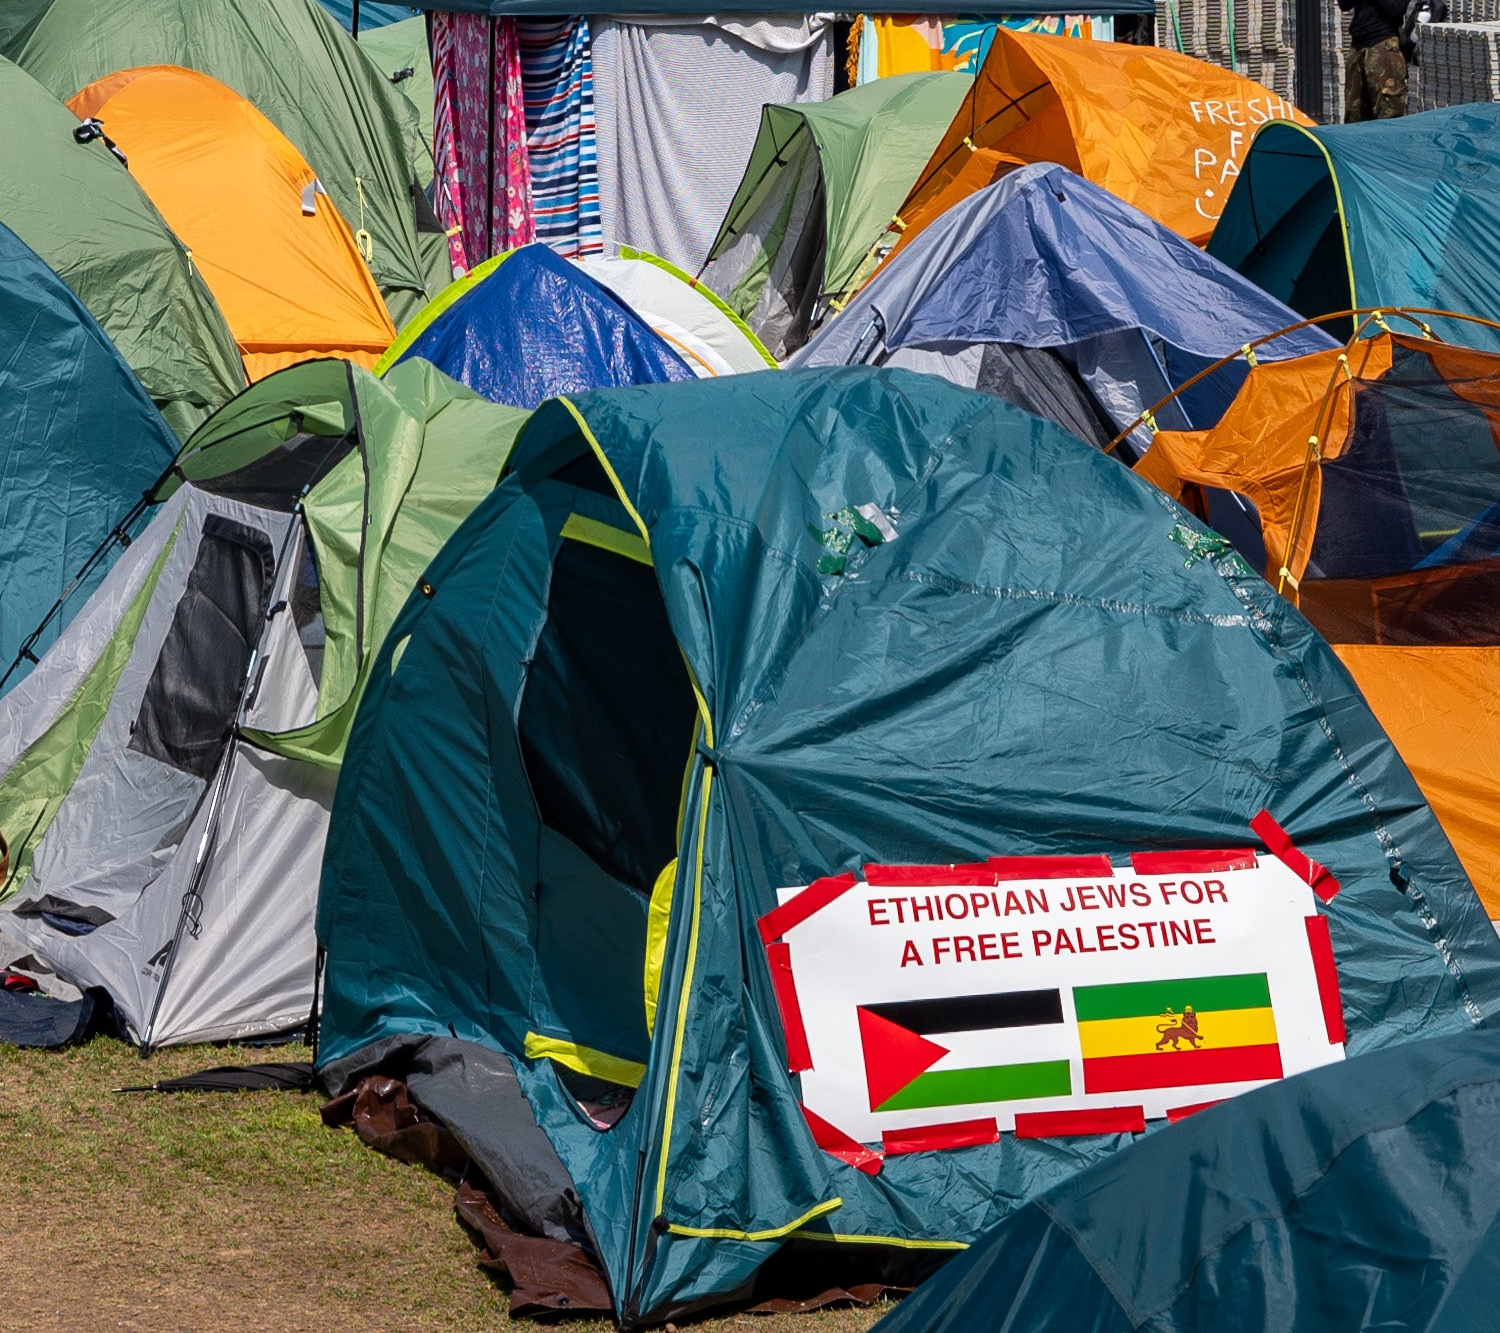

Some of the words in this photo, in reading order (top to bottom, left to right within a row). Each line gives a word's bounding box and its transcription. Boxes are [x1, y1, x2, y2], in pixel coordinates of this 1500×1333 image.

[867, 888, 1050, 926] ETHIOPIAN
[1059, 882, 1152, 913] JEWS
[1158, 879, 1229, 906] FOR
[900, 939, 924, 968] A
[931, 931, 1023, 965] FREE
[1031, 918, 1217, 957] PALESTINE
